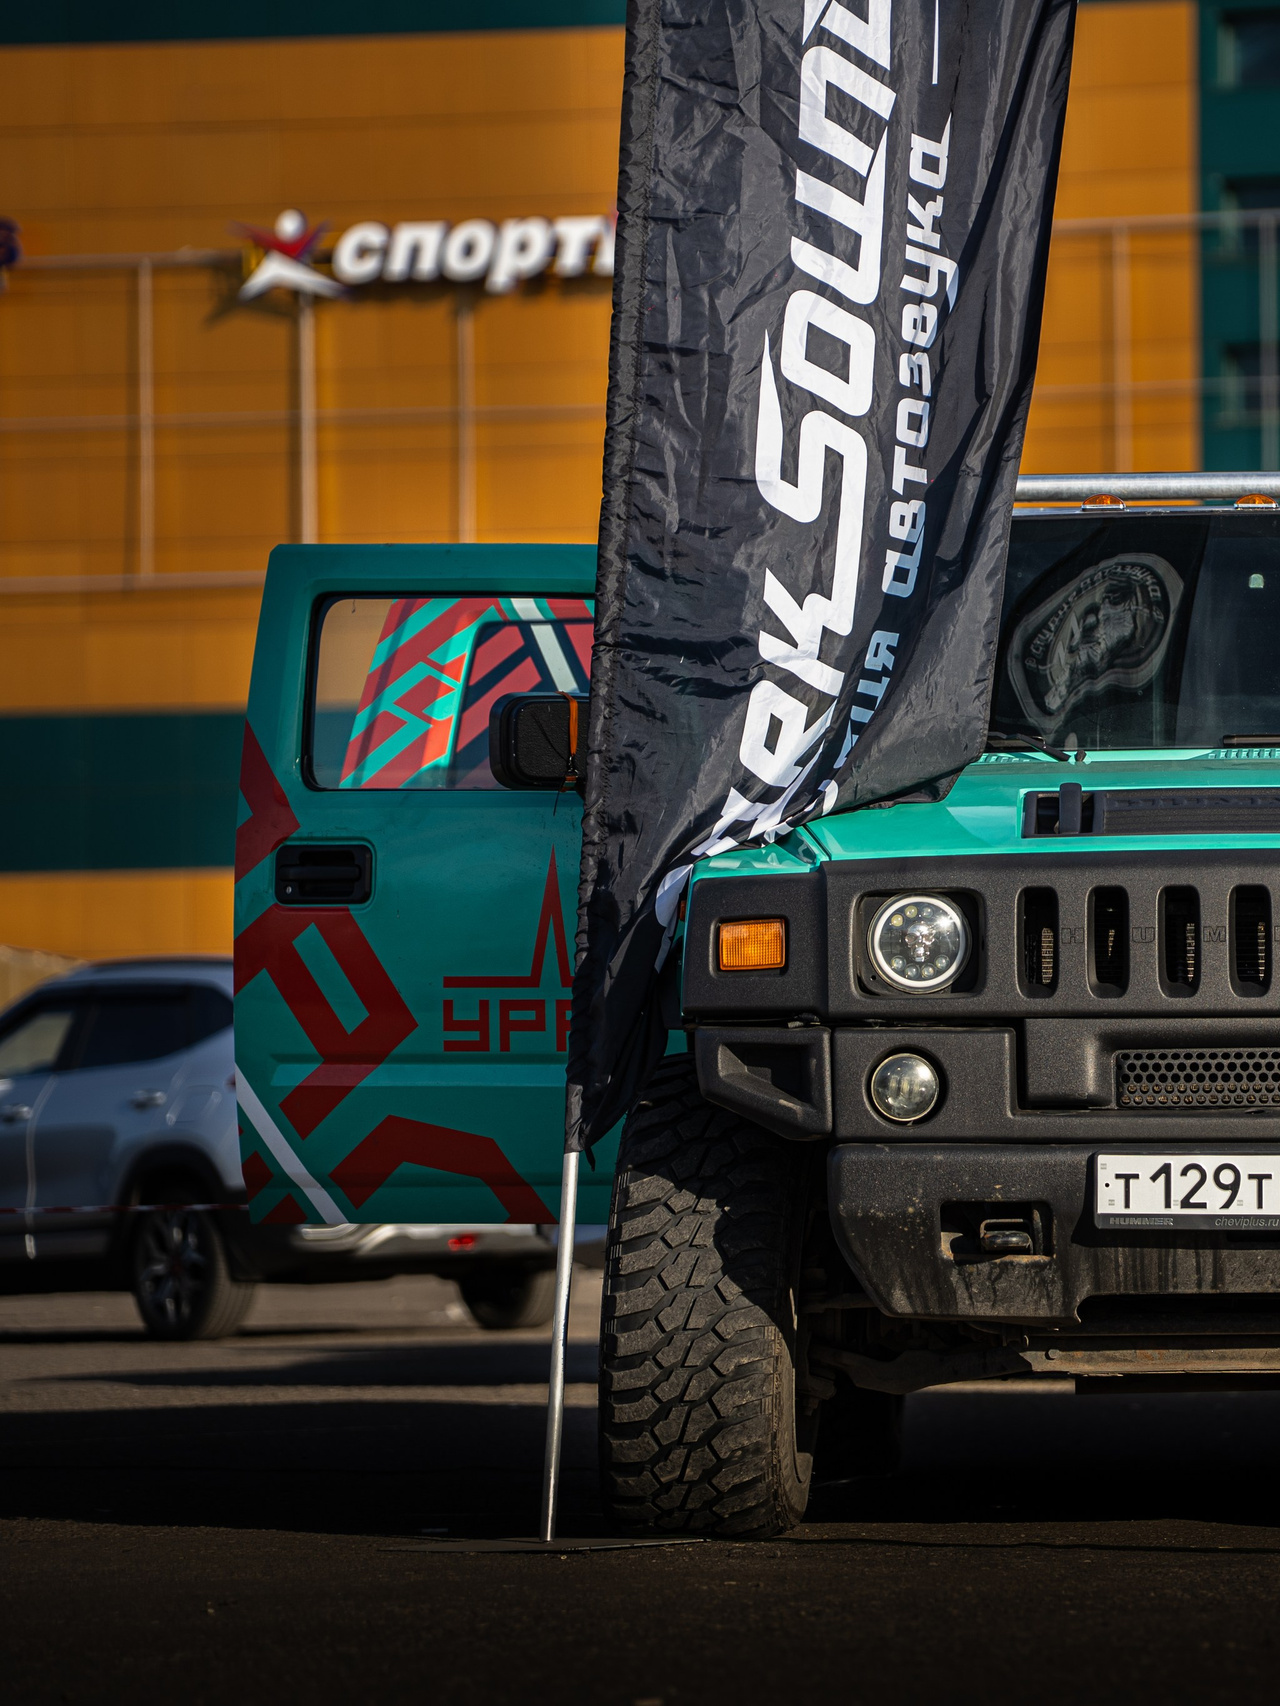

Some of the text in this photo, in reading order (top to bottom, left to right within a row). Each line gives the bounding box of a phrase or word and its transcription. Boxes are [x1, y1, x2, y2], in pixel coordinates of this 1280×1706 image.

[333, 214, 615, 293] спорт
[1109, 1216, 1174, 1226] HUMMER
[1215, 1216, 1280, 1229] cheviplus.ru
